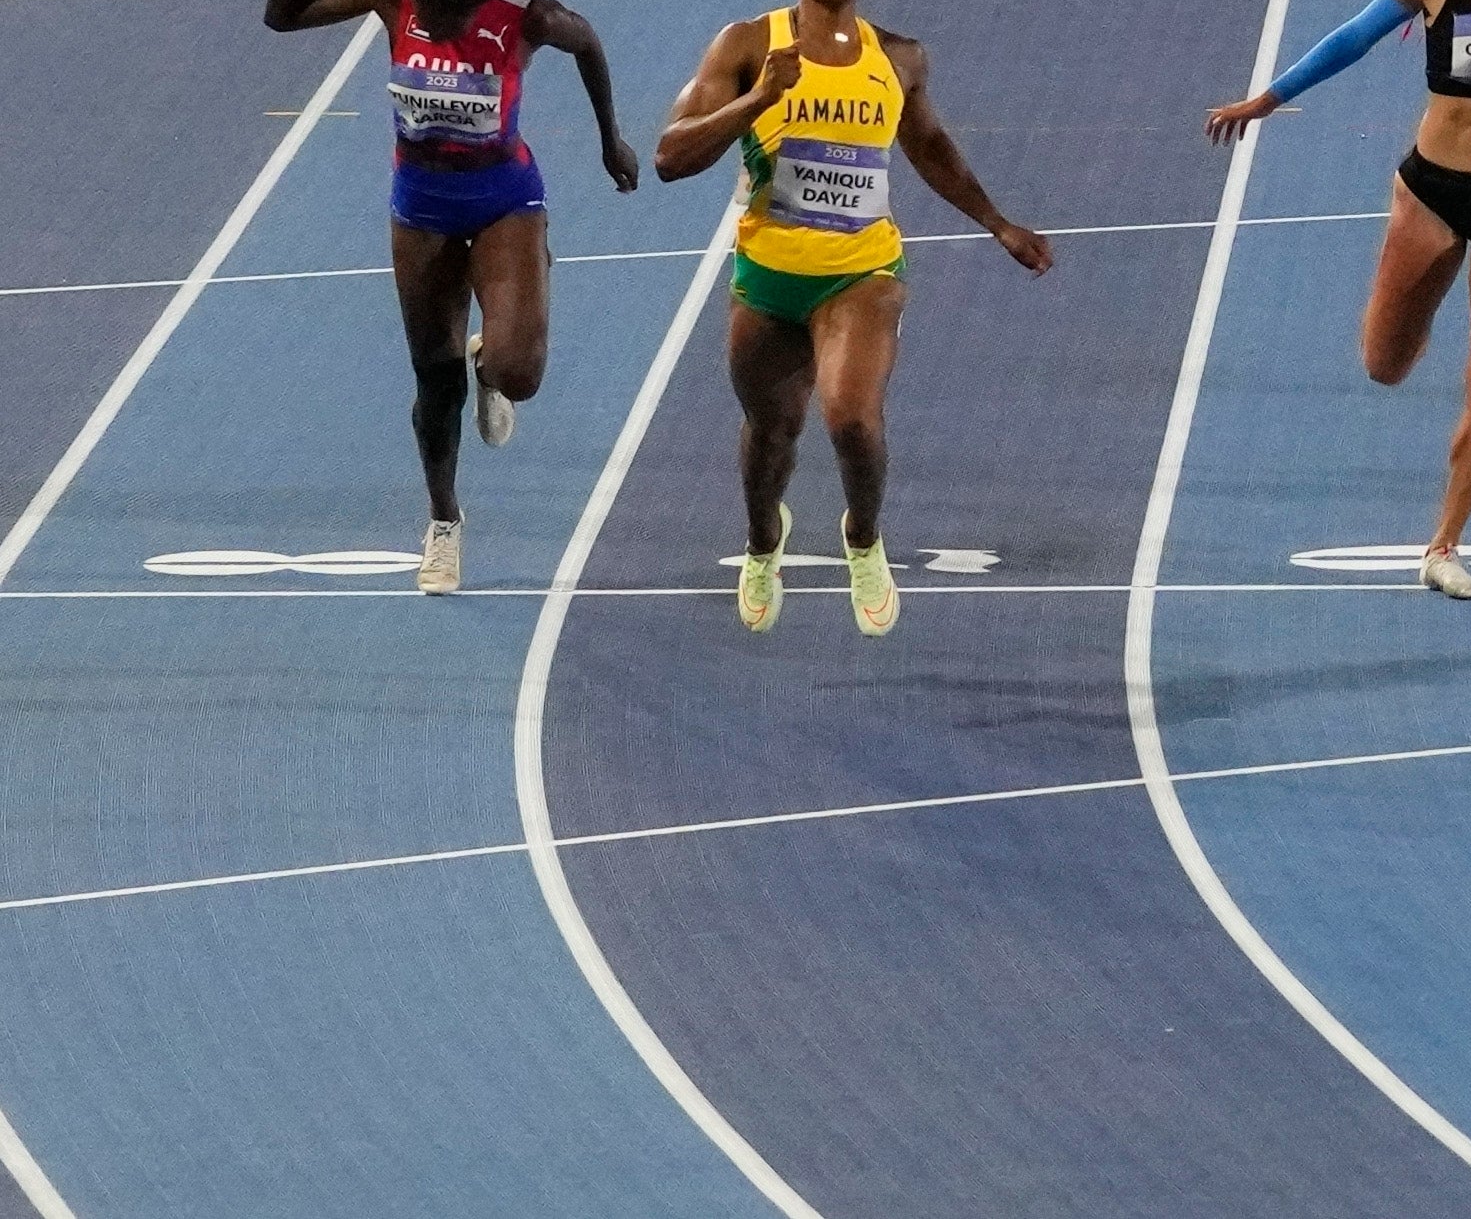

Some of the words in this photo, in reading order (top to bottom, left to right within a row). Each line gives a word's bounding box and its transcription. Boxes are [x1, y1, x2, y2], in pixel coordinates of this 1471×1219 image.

[425, 76, 458, 88] 2023
[411, 110, 476, 127] GARCIA
[783, 98, 885, 127] JAMAICA
[825, 147, 857, 162] 2023
[793, 165, 875, 190] YANIQUE
[802, 187, 860, 208] DAYLE
